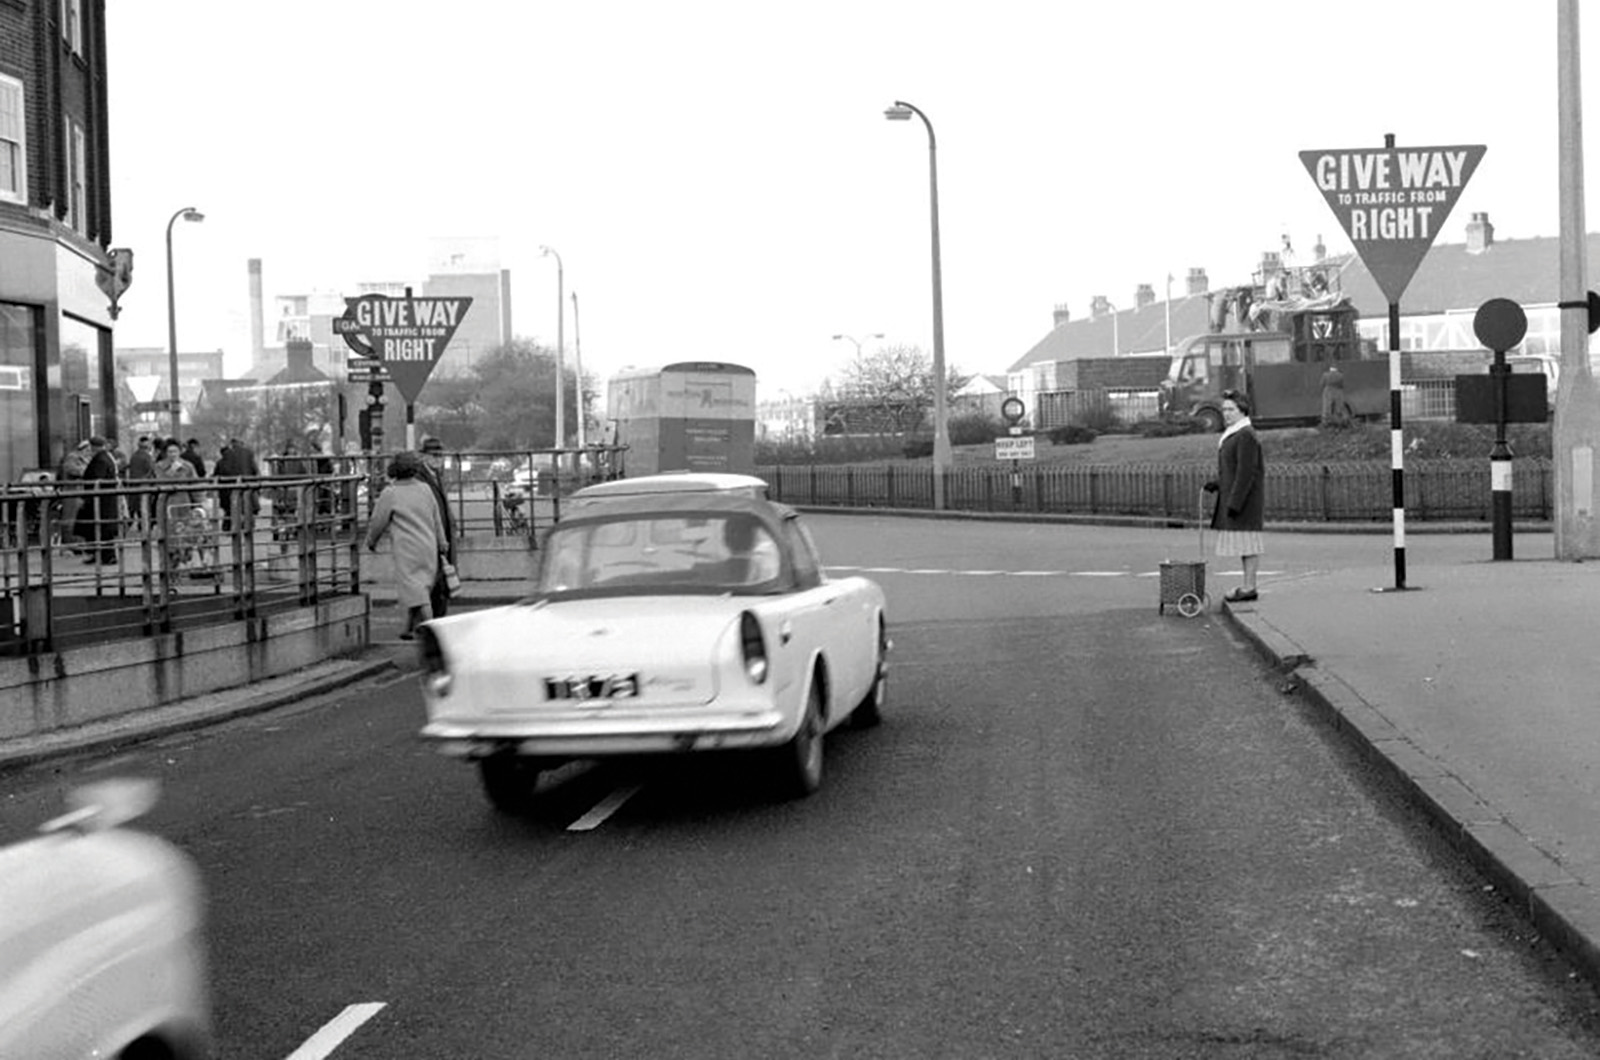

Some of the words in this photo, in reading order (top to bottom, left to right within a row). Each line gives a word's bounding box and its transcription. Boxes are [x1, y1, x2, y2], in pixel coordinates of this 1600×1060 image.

[1316, 153, 1390, 191] GIVE
[1397, 151, 1467, 188] WAY
[1338, 193, 1352, 205] TO
[1355, 191, 1405, 204] TRAFFIC
[1411, 190, 1446, 203] FROM
[1351, 206, 1432, 240] RIGHT
[356, 300, 408, 327] GIVE
[413, 300, 459, 327] WAY
[384, 327, 418, 336] TRAFFIC
[384, 338, 436, 361] RIGHT
